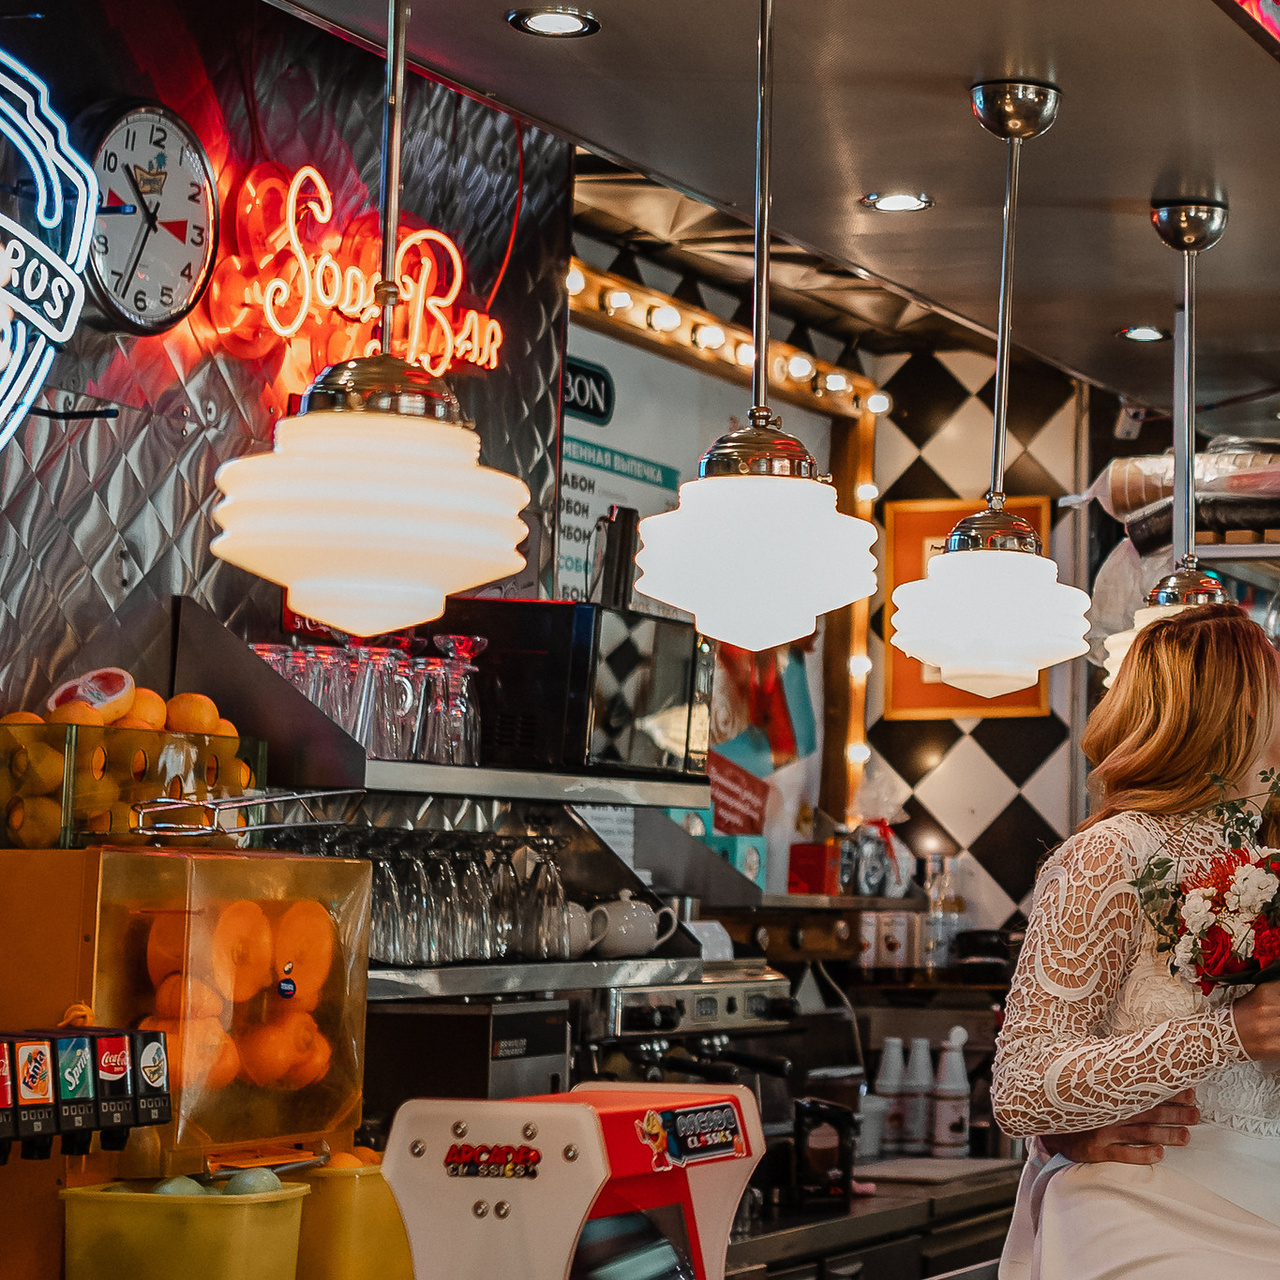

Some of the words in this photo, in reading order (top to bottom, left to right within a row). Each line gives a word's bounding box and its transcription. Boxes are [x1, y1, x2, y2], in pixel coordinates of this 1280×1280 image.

[125, 128, 137, 152] 11
[149, 124, 168, 150] 12
[102, 149, 118, 172] 10
[179, 145, 185, 167] 1
[187, 181, 202, 205] 2
[190, 224, 206, 248] 3
[110, 270, 124, 293] 7
[180, 262, 193, 284] 4
[133, 290, 148, 312] 6
[159, 286, 174, 308] 5
[22, 1049, 46, 1091] Fanta
